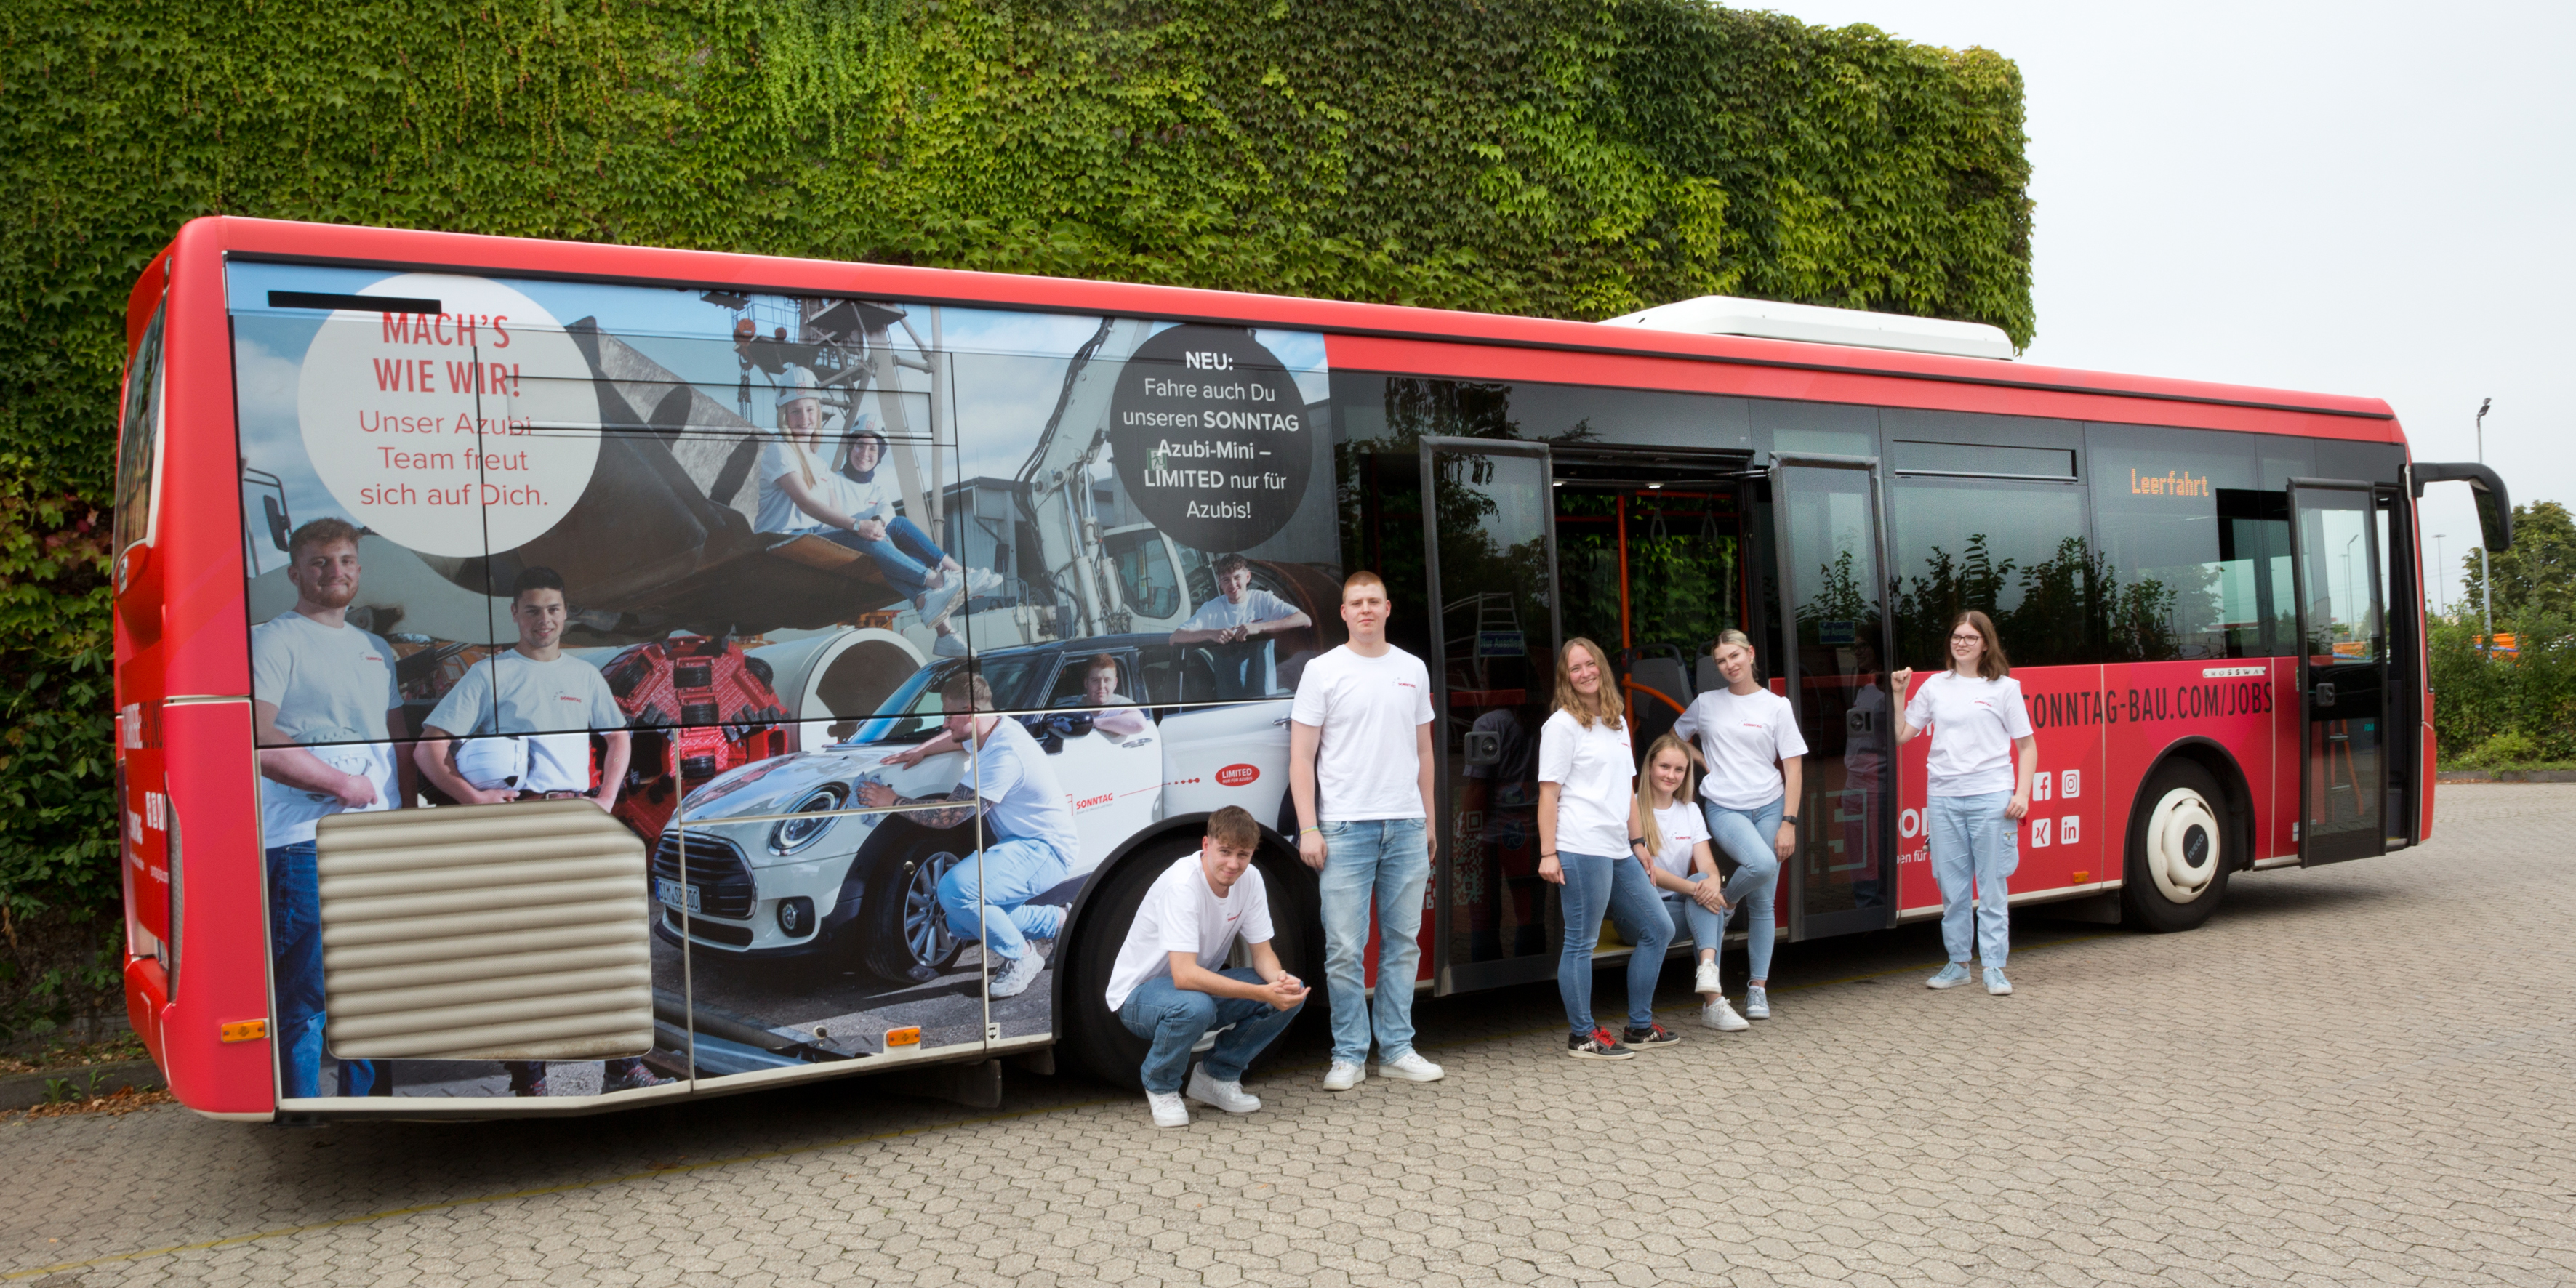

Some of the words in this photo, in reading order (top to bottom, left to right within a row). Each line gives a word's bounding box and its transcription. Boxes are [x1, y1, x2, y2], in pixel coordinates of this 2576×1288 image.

[1185, 351, 1234, 371] NEU:
[373, 358, 435, 393] WIE
[446, 361, 520, 398] WIR!
[1144, 378, 1197, 398] Fahre
[1203, 383, 1245, 400] auch
[1251, 384, 1275, 401] Du
[360, 410, 444, 434] Unser
[454, 413, 532, 435] Azubi
[1123, 411, 1197, 427] unseren
[1203, 411, 1299, 432] SONNTAG
[377, 446, 454, 470] Team
[463, 448, 529, 471] freut
[1157, 439, 1254, 459] Azubi-Mini
[1144, 470, 1224, 488] LIMITED
[1230, 475, 1259, 488] nur
[1263, 472, 1287, 490] für
[2131, 468, 2209, 497] Leerfahrt
[361, 483, 417, 505] sich
[428, 483, 472, 505] auf
[481, 483, 548, 506] Dich.
[1186, 500, 1251, 519] Azubis!
[1222, 768, 1252, 778] LIMITED
[1075, 792, 1113, 810] SONNTAG
[2187, 834, 2204, 859] IVECO
